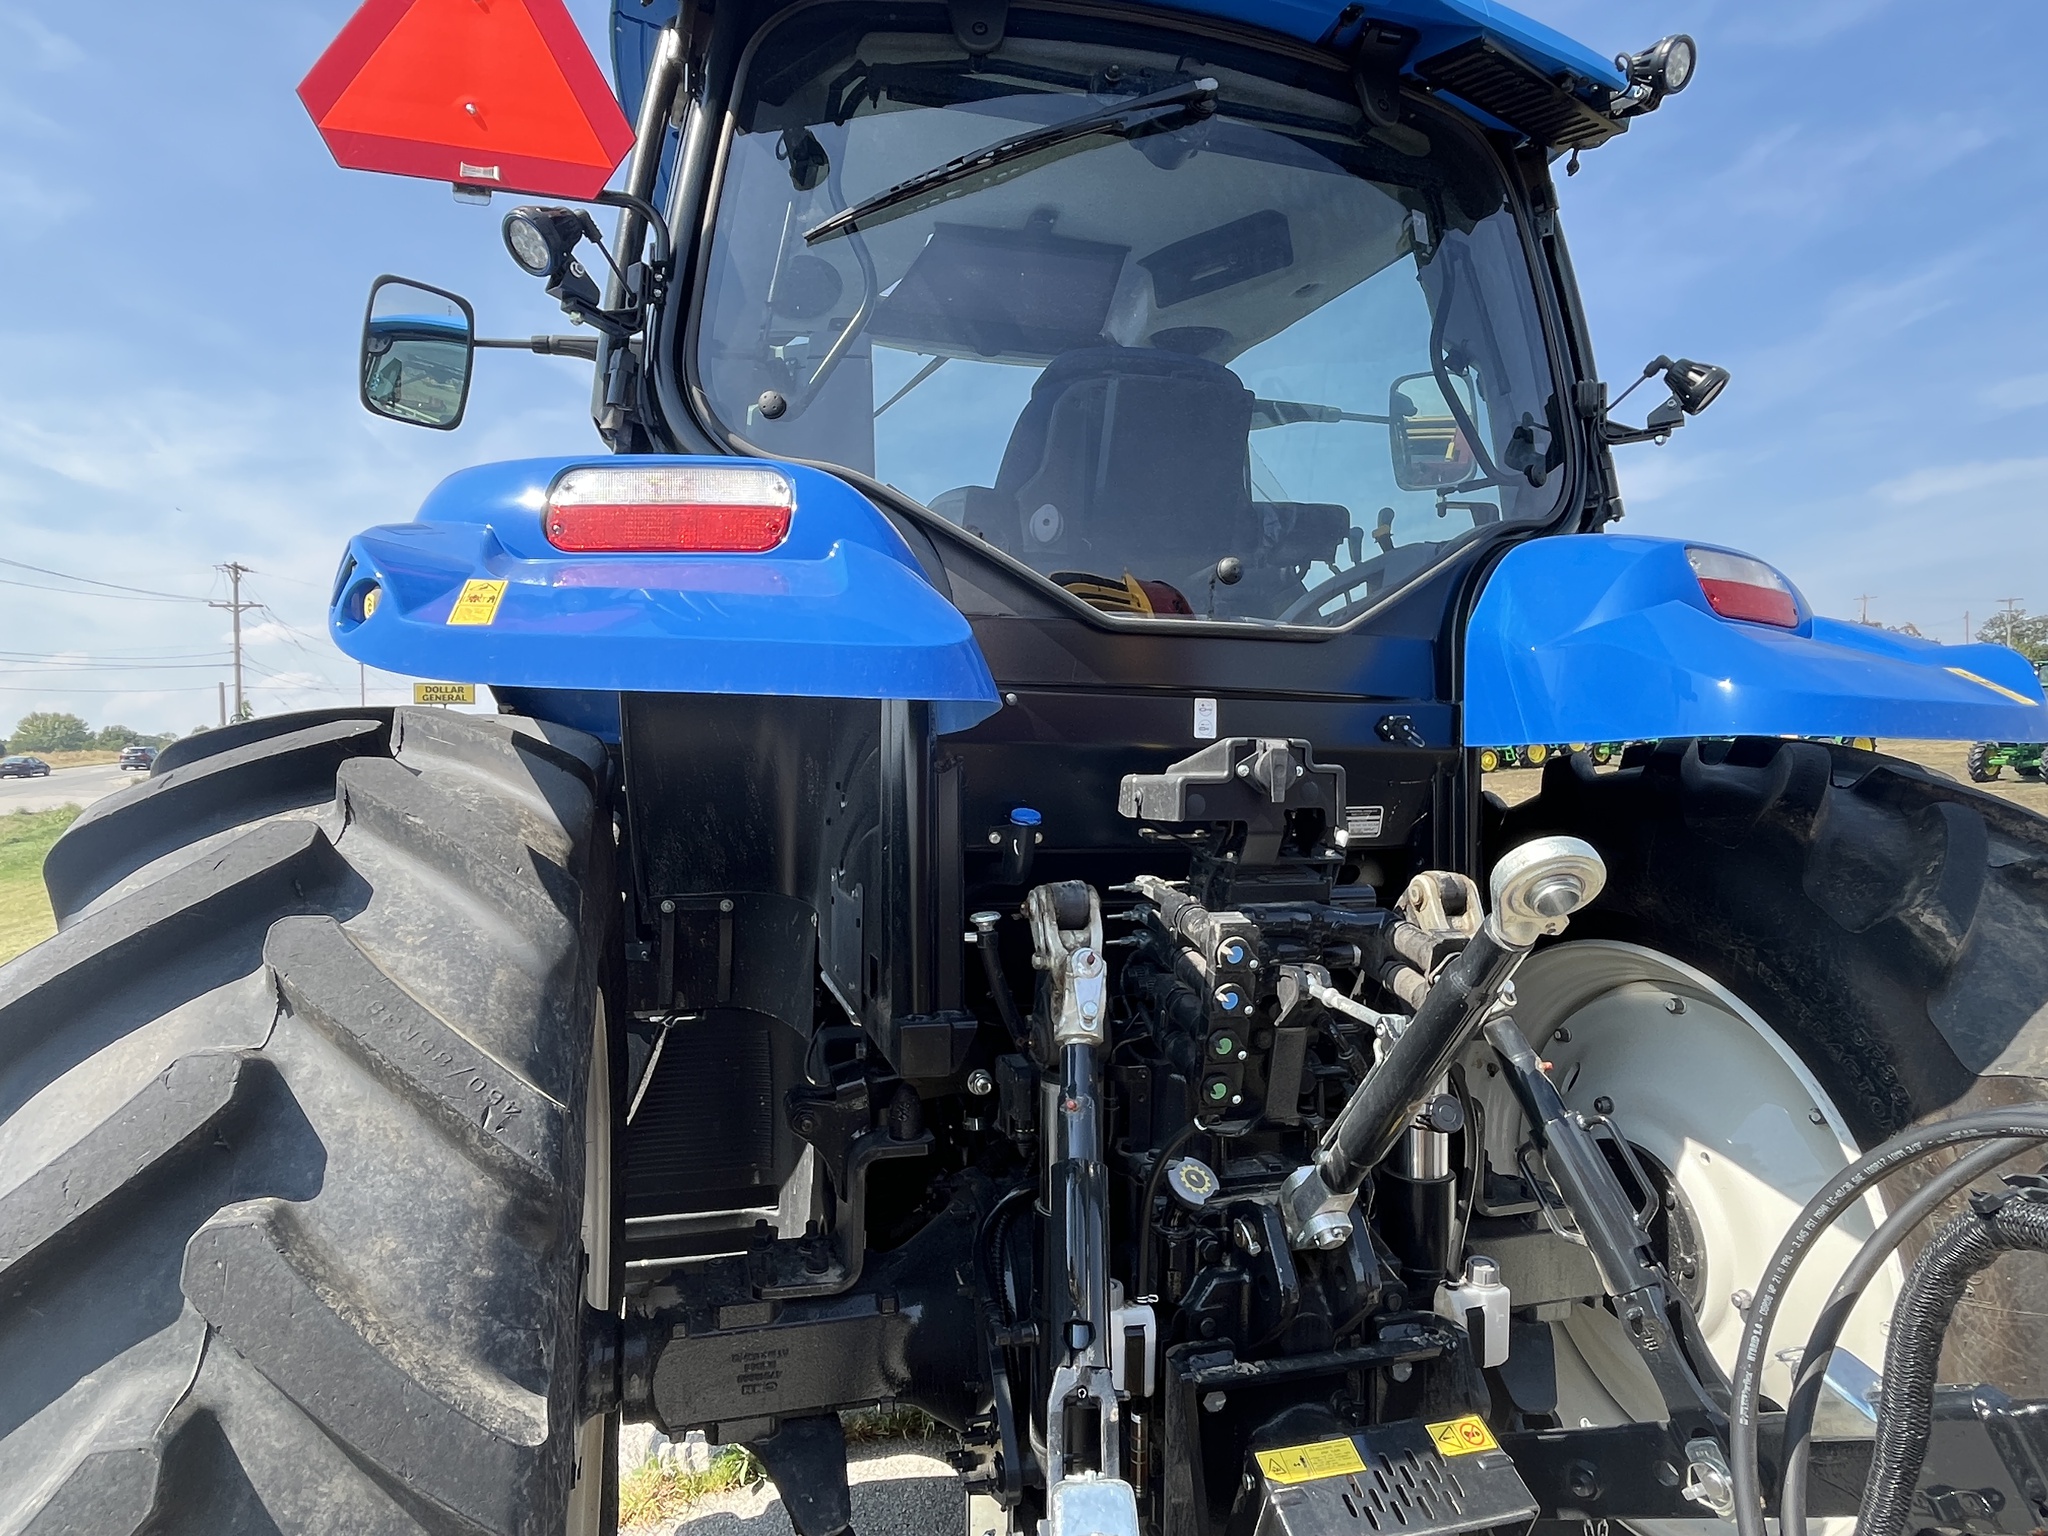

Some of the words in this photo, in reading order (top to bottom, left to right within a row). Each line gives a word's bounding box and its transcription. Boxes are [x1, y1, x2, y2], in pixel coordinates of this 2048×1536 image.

[425, 686, 465, 694] DOLLAR
[422, 694, 467, 702] GENERAL
[1804, 1218, 1818, 1231] PSI
